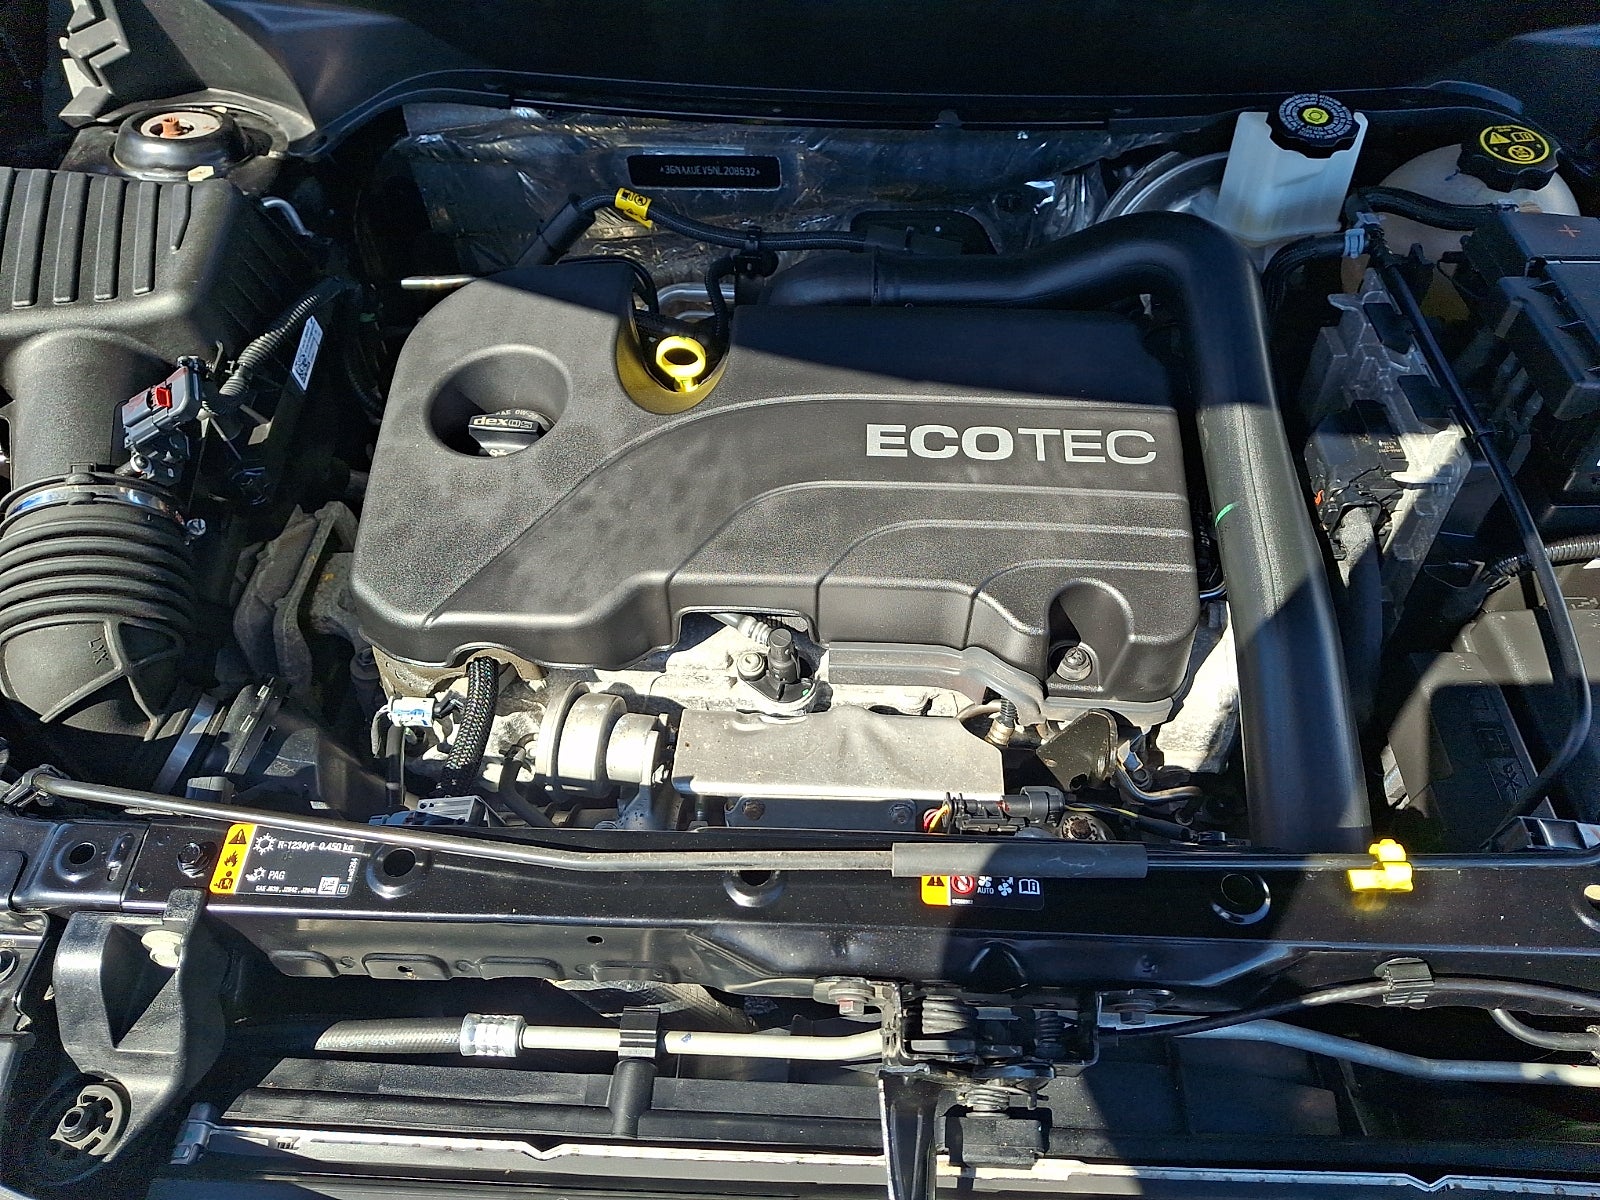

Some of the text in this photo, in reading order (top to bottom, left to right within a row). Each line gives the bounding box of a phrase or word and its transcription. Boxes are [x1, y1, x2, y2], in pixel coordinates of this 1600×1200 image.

[473, 416, 533, 429] dexos
[866, 423, 1157, 465] ECOTEC
[318, 841, 342, 851] 0.450
[343, 842, 355, 852] kg
[267, 870, 286, 880] PAG
[255, 884, 267, 893] SAE
[977, 886, 995, 895] AUTO
